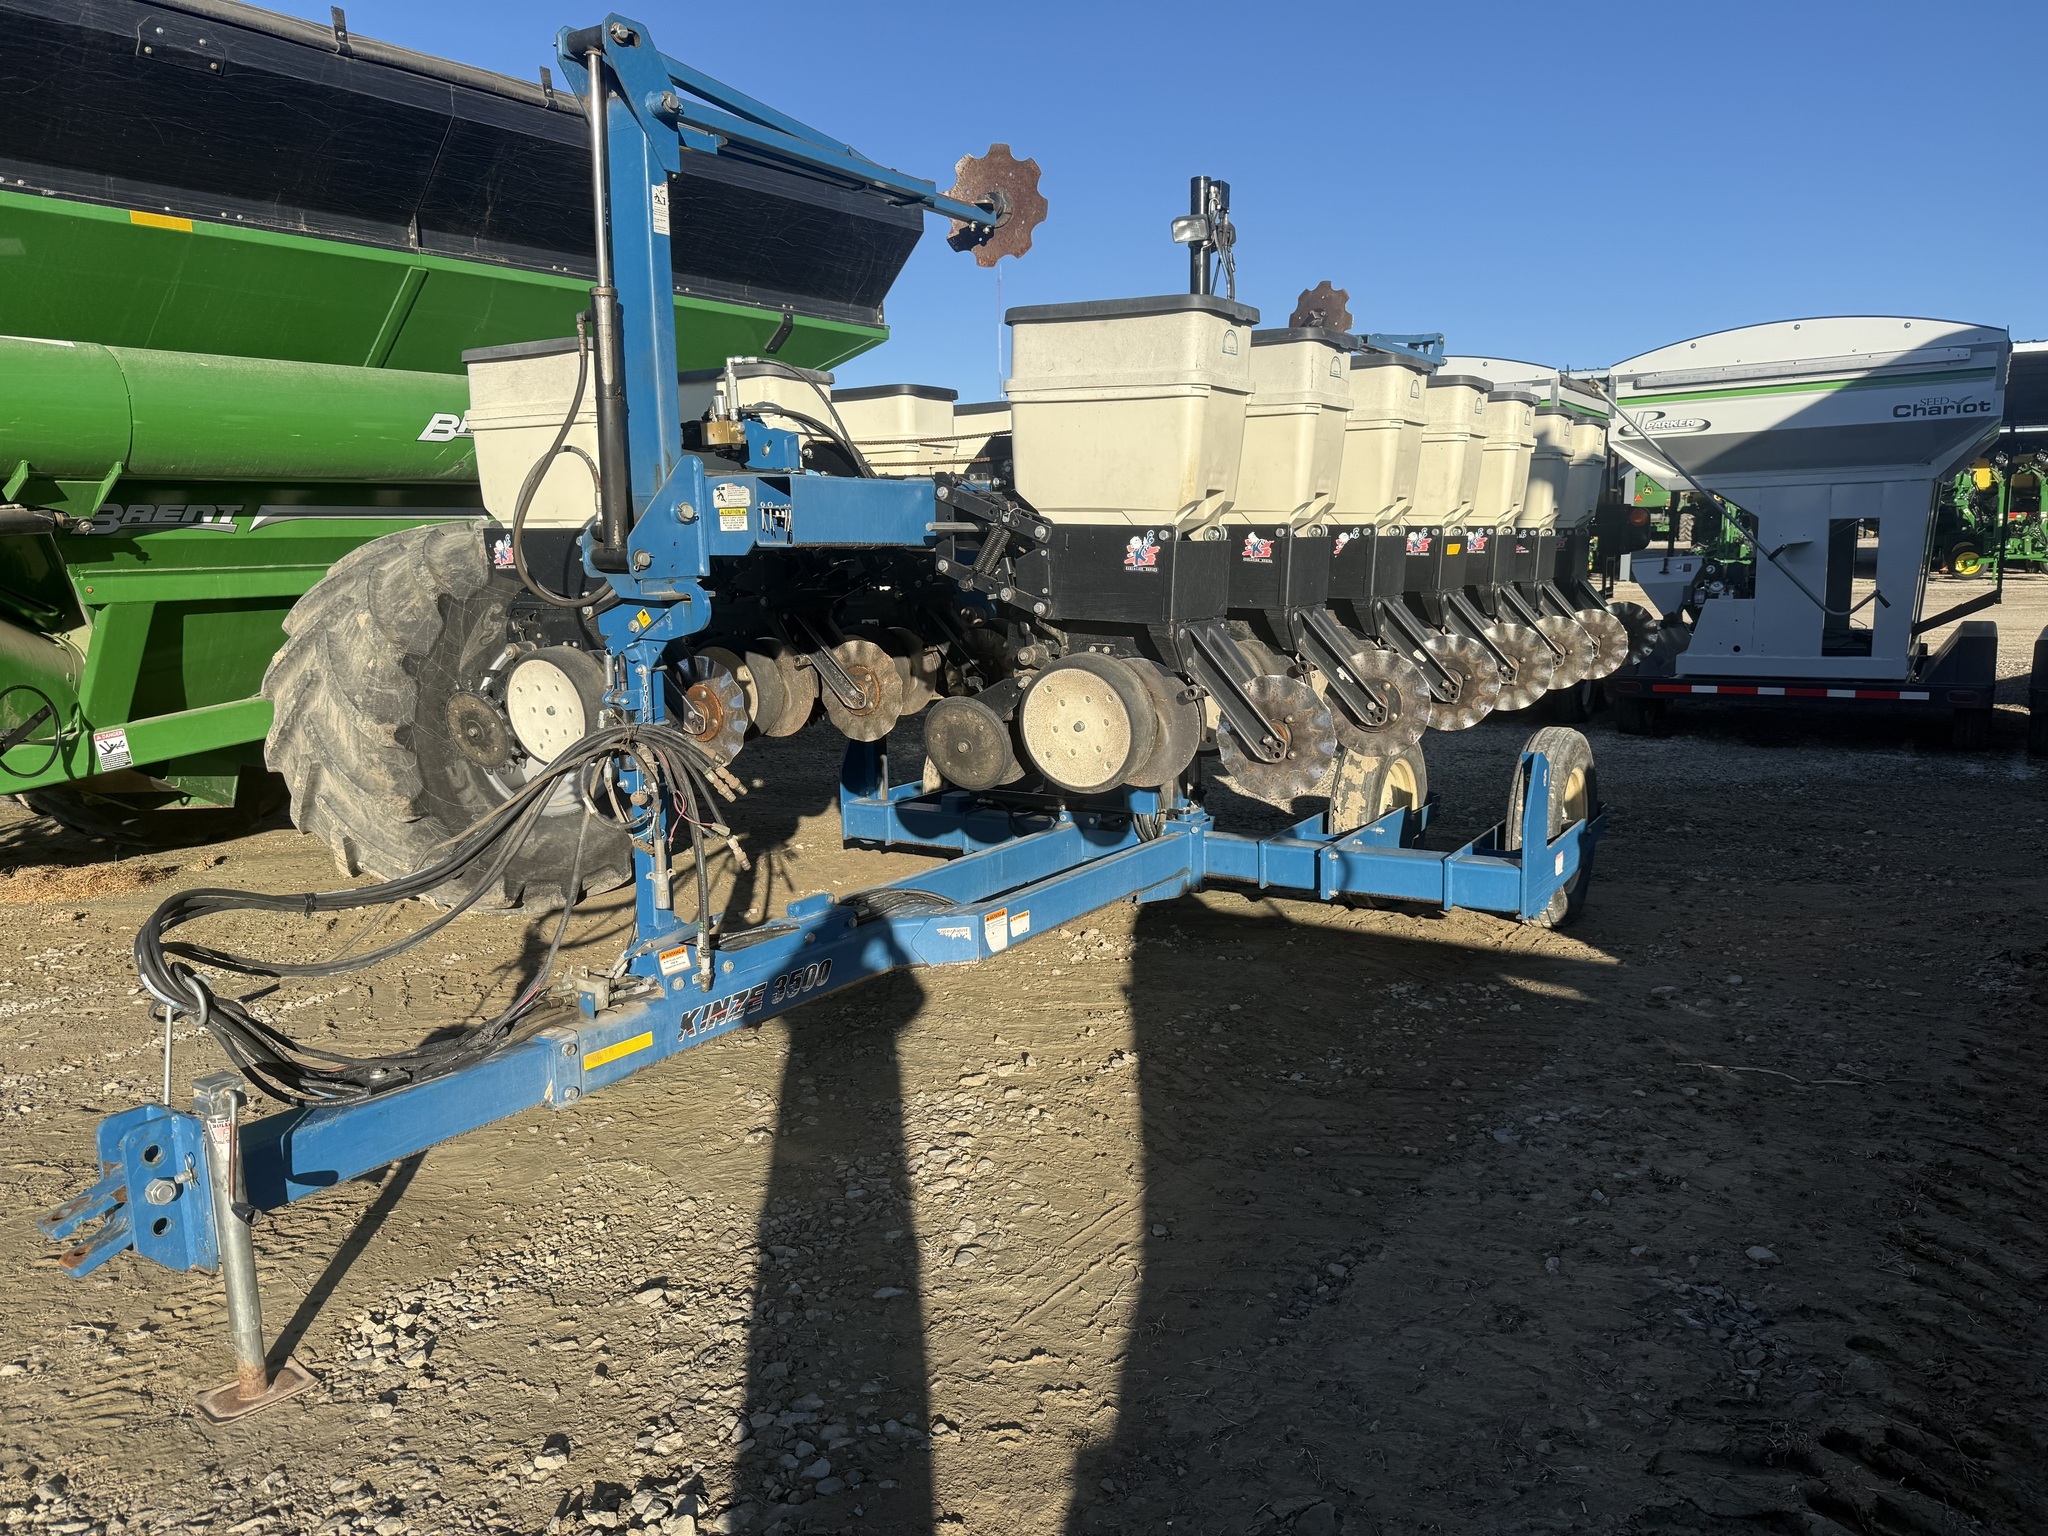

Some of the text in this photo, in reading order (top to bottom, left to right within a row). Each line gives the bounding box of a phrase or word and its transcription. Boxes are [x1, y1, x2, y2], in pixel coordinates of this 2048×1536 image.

[1920, 396, 1950, 407] SEED
[1893, 401, 1991, 418] Chariot
[1645, 419, 1695, 430] PARKER
[71, 503, 245, 535] BRENT
[102, 730, 123, 739] DANGER
[677, 957, 833, 1042] KINZE 3500
